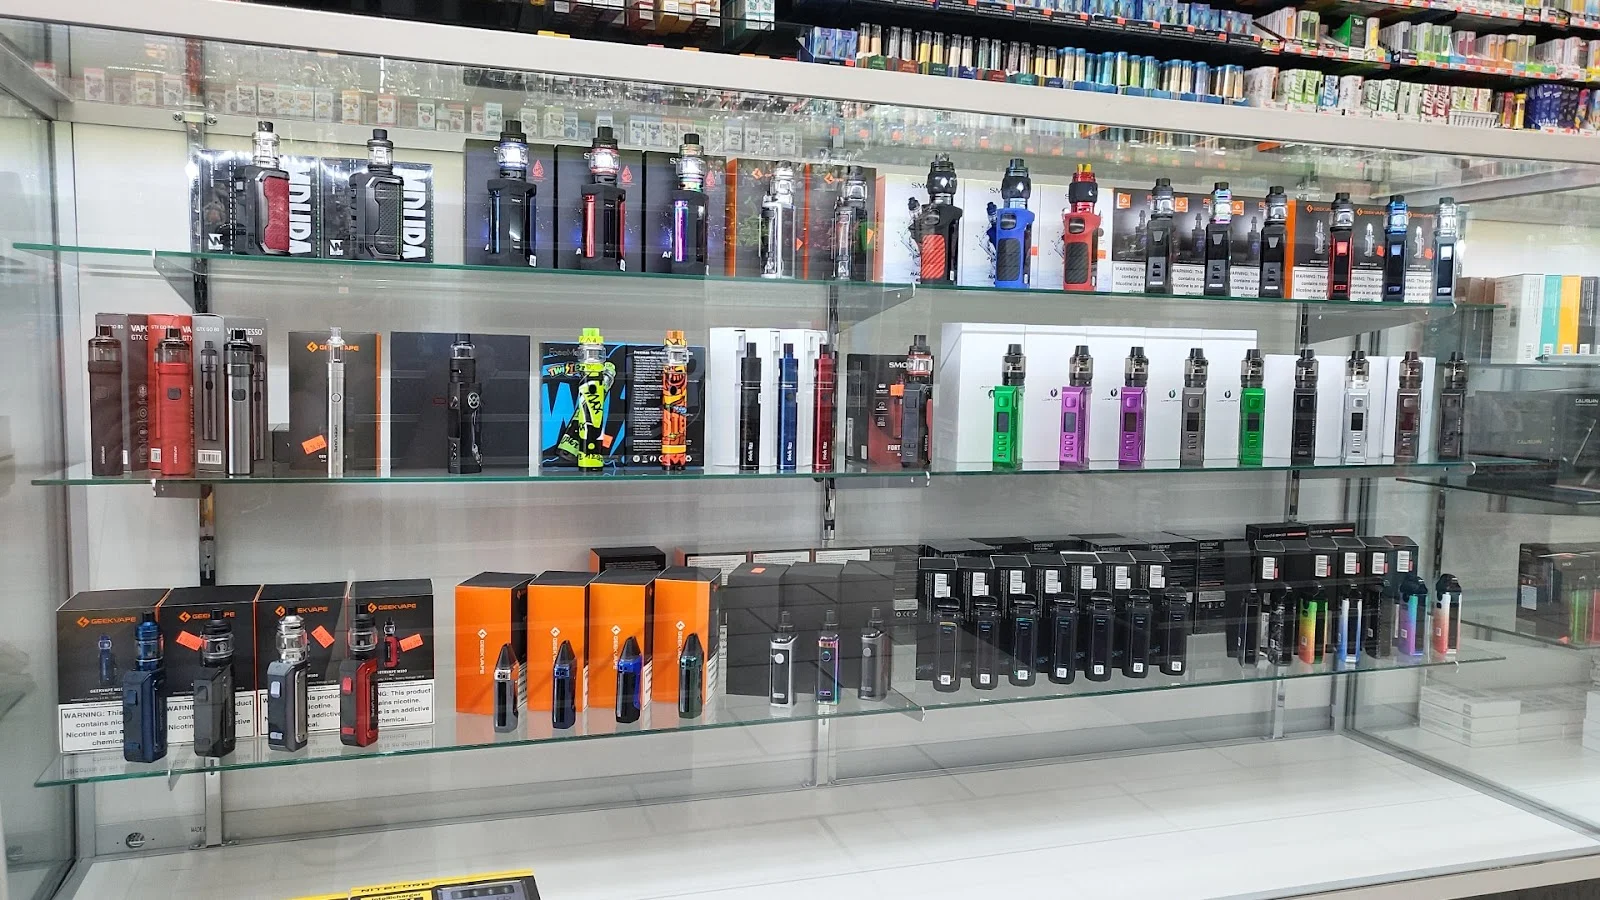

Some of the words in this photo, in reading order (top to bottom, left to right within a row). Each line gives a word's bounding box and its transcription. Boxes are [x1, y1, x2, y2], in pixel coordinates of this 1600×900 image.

[226, 328, 263, 336] VESSO
[378, 602, 416, 610] GEEKVAPE
[91, 616, 137, 625] GEEKVAPE
[406, 688, 430, 698] product
[64, 711, 105, 719] WARNING:
[360, 882, 430, 893] NITECORE
